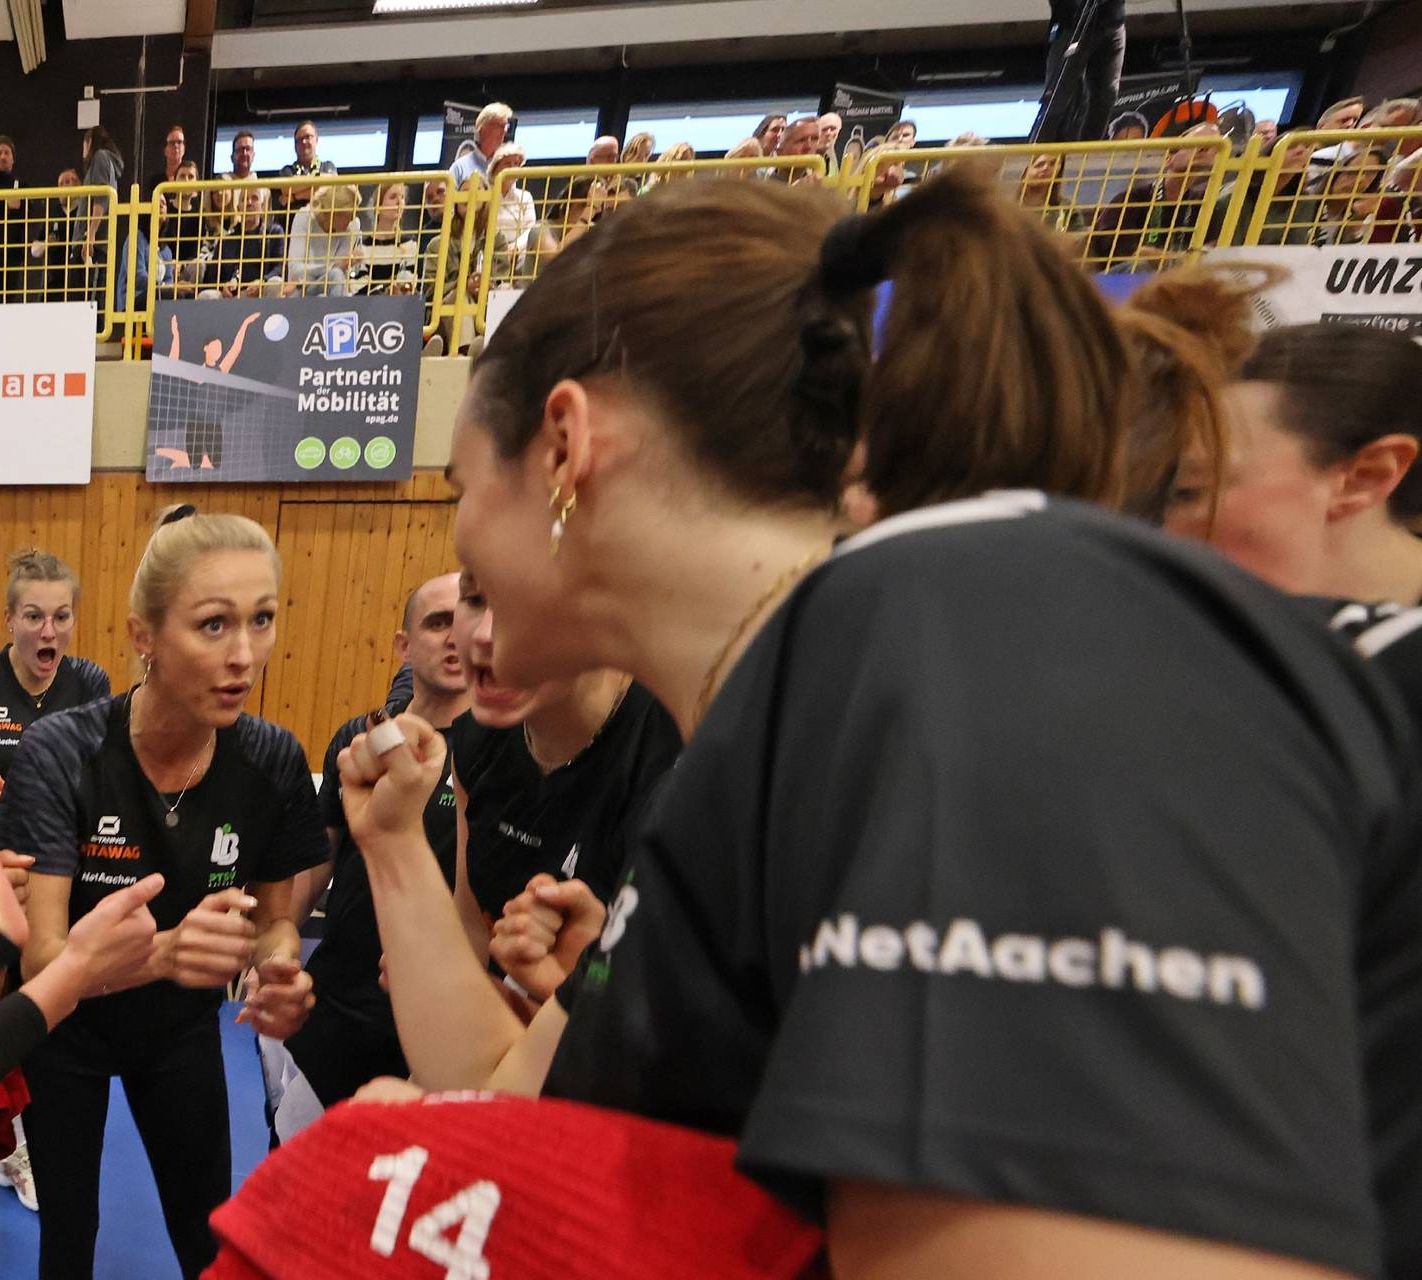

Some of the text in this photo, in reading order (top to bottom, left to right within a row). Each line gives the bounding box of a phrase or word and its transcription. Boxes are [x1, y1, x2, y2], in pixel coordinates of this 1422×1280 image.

[1325, 258, 1422, 294] UMZ
[302, 312, 405, 360] APAG
[299, 365, 402, 386] Partnerin
[316, 386, 331, 395] der
[298, 391, 400, 412] Mobilität
[365, 415, 399, 424] apag.de
[368, 1145, 500, 1280] 14
